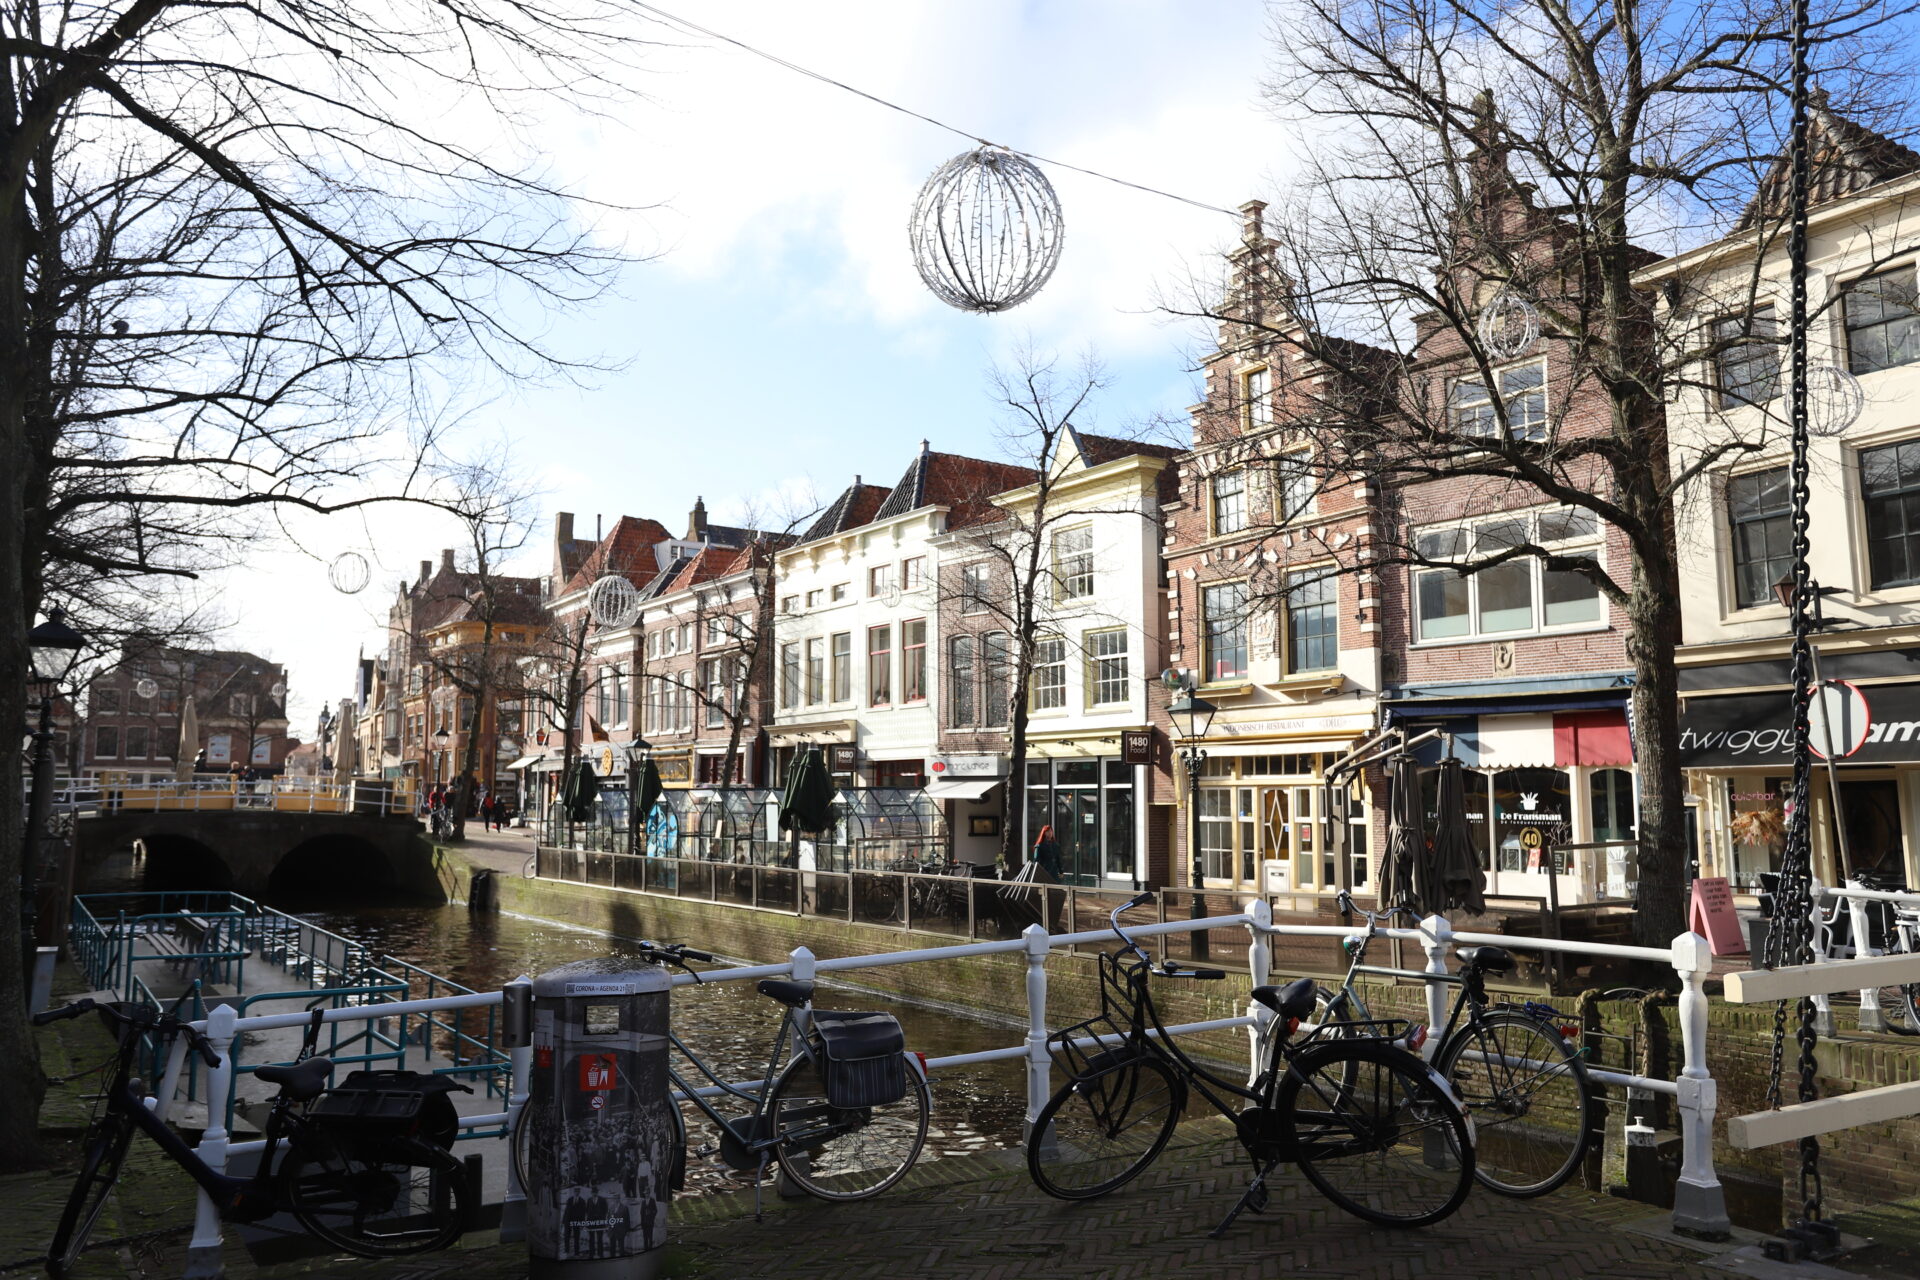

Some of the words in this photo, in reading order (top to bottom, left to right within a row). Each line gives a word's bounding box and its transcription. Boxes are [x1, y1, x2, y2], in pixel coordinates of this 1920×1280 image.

[1266, 720, 1304, 731] RESTAURANT
[1129, 736, 1148, 747] 1480
[1679, 727, 1796, 755] twiggy
[837, 750, 854, 759] 1480
[1500, 812, 1512, 820] De
[1513, 812, 1562, 821] Fransman
[1524, 833, 1538, 846] 40
